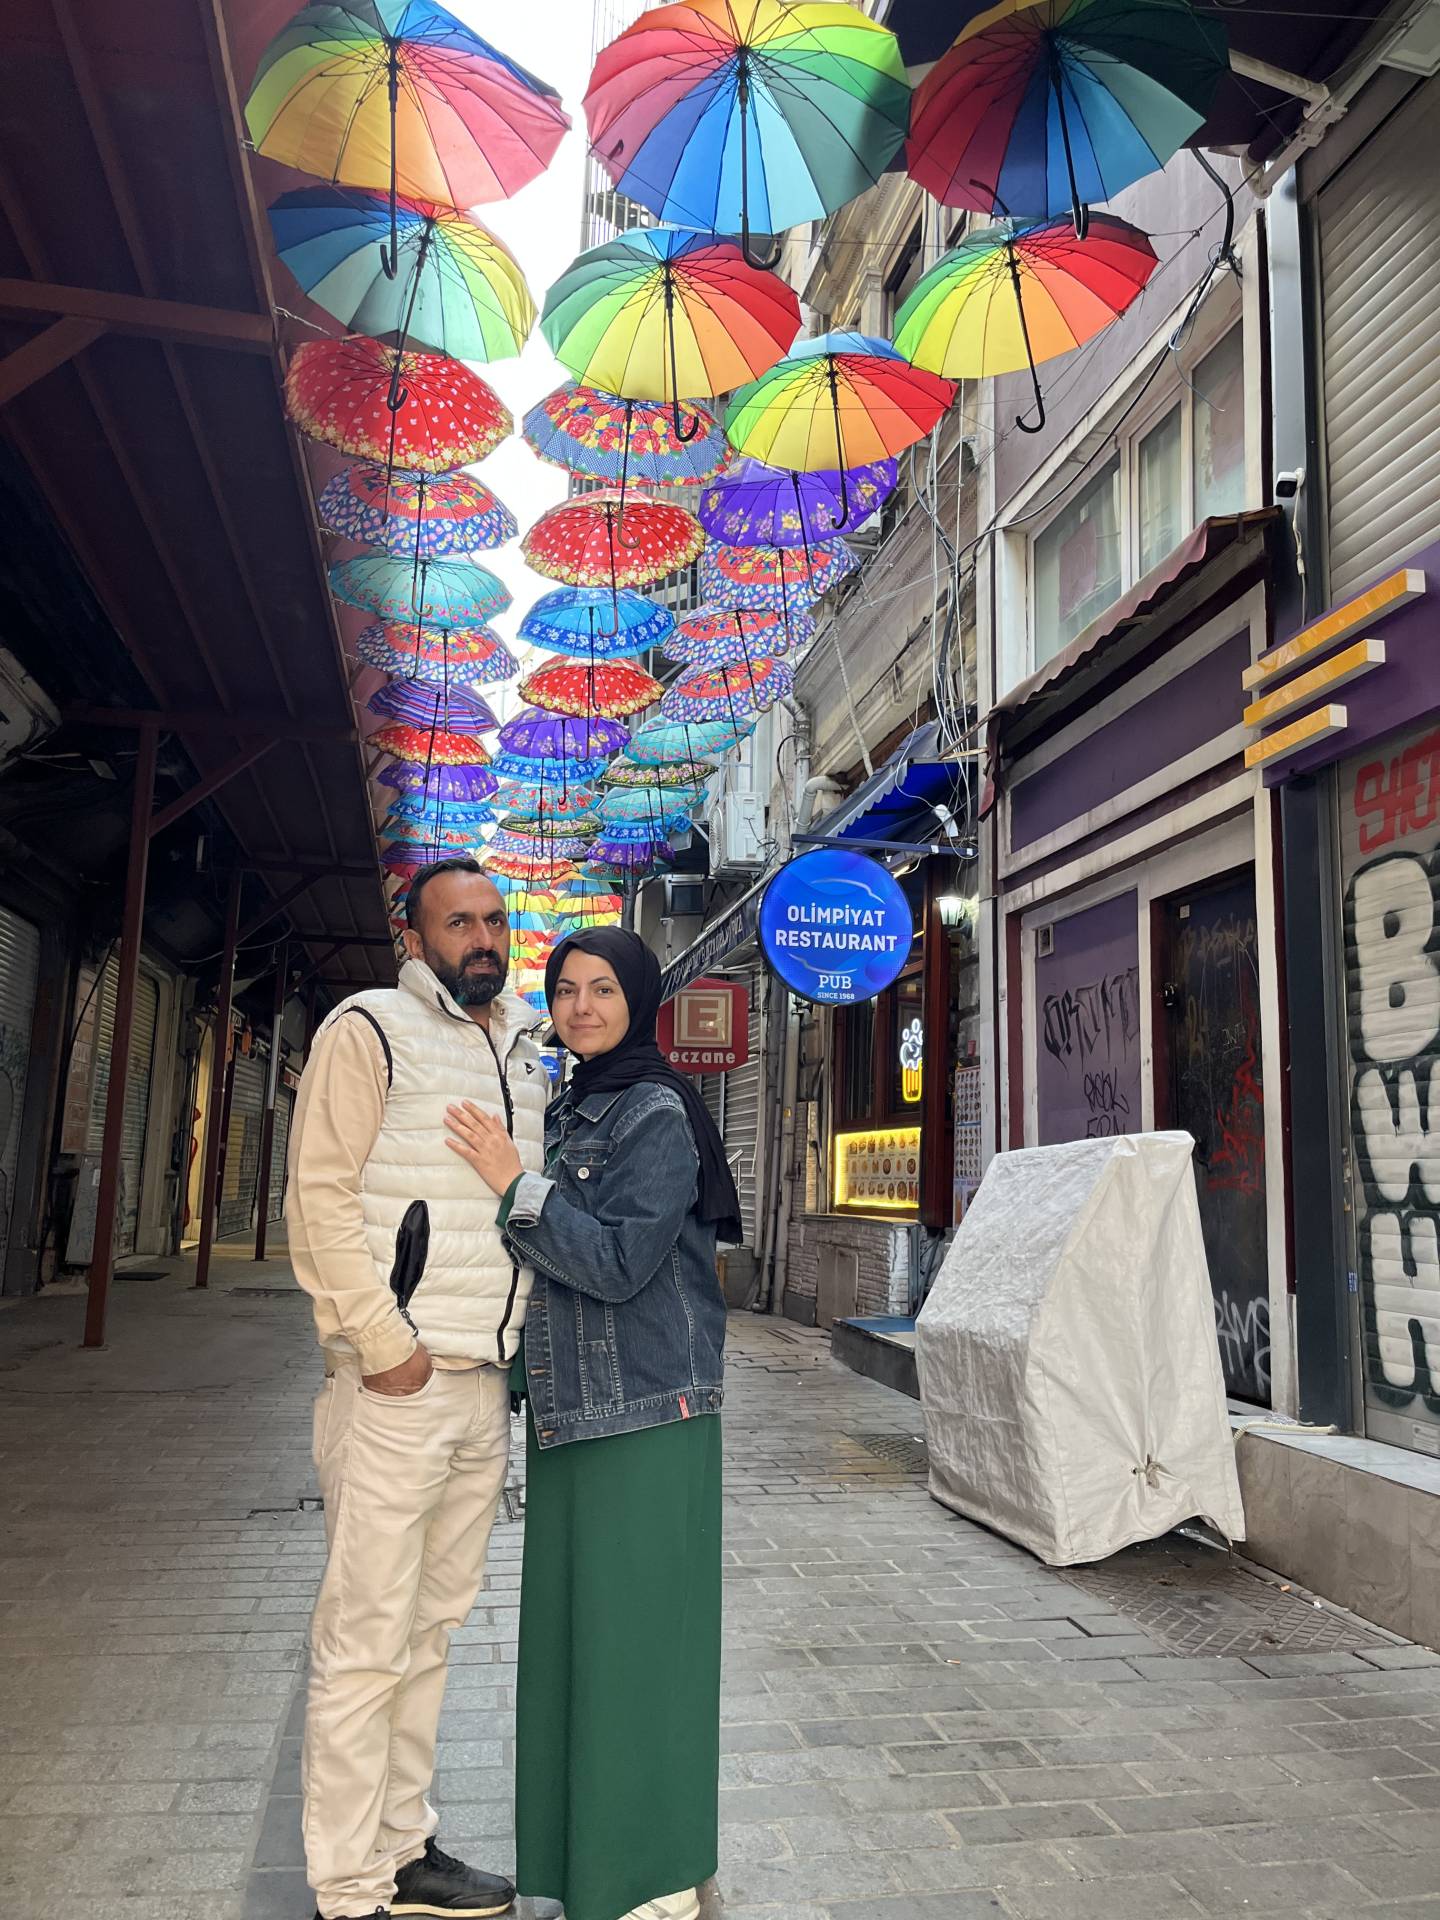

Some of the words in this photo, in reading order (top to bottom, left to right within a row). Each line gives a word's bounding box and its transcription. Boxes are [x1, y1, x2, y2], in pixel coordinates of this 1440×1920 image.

[787, 902, 886, 927] OLİMPİYAT
[775, 929, 898, 952] RESTAURANT
[818, 974, 852, 989] PUB
[817, 991, 838, 999] SINCE
[839, 992, 855, 1000] 1968
[669, 1051, 736, 1064] eczane
